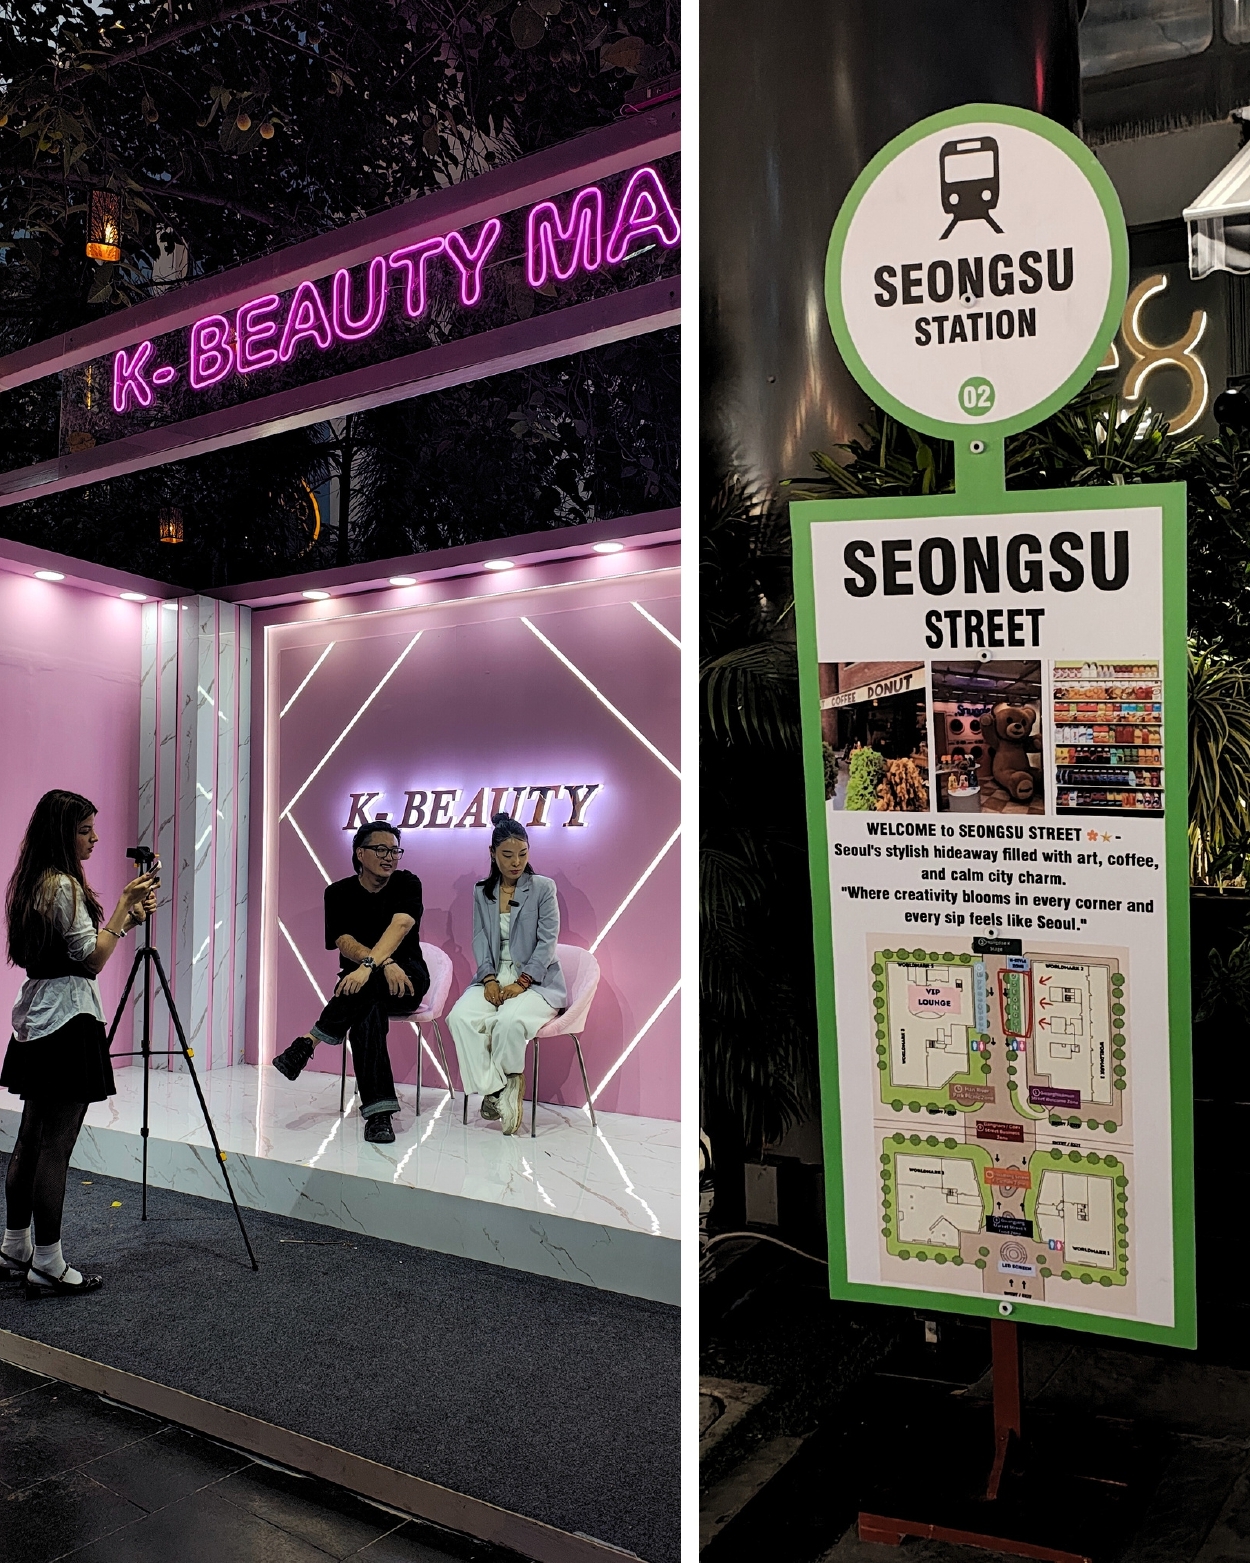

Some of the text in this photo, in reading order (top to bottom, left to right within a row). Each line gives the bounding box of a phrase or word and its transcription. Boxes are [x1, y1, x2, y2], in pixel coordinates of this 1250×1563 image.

[189, 217, 502, 390] BEAUTY
[527, 166, 681, 287] MA
[874, 247, 1074, 308] SEONGSU
[915, 307, 1037, 346] STATION
[963, 385, 991, 409] 02
[843, 530, 1130, 598] SEONGSU
[925, 608, 1045, 650] STREET
[832, 674, 913, 707] COFFEE DONUT
[397, 784, 604, 829] BEAUTY
[867, 822, 937, 838] WELCOME
[941, 824, 955, 837] to
[959, 824, 1024, 839] SEONGSU
[1029, 826, 1082, 841] STREET
[834, 843, 1159, 869] Seoul's stylish hideaway filled with art, coffee,
[921, 867, 1067, 886] and calm city charm.
[842, 886, 1154, 914] "Where creativity blooms in every corner and
[904, 911, 1087, 931] every sip feels like Seoul."
[918, 999, 951, 1007] LOUNGE
